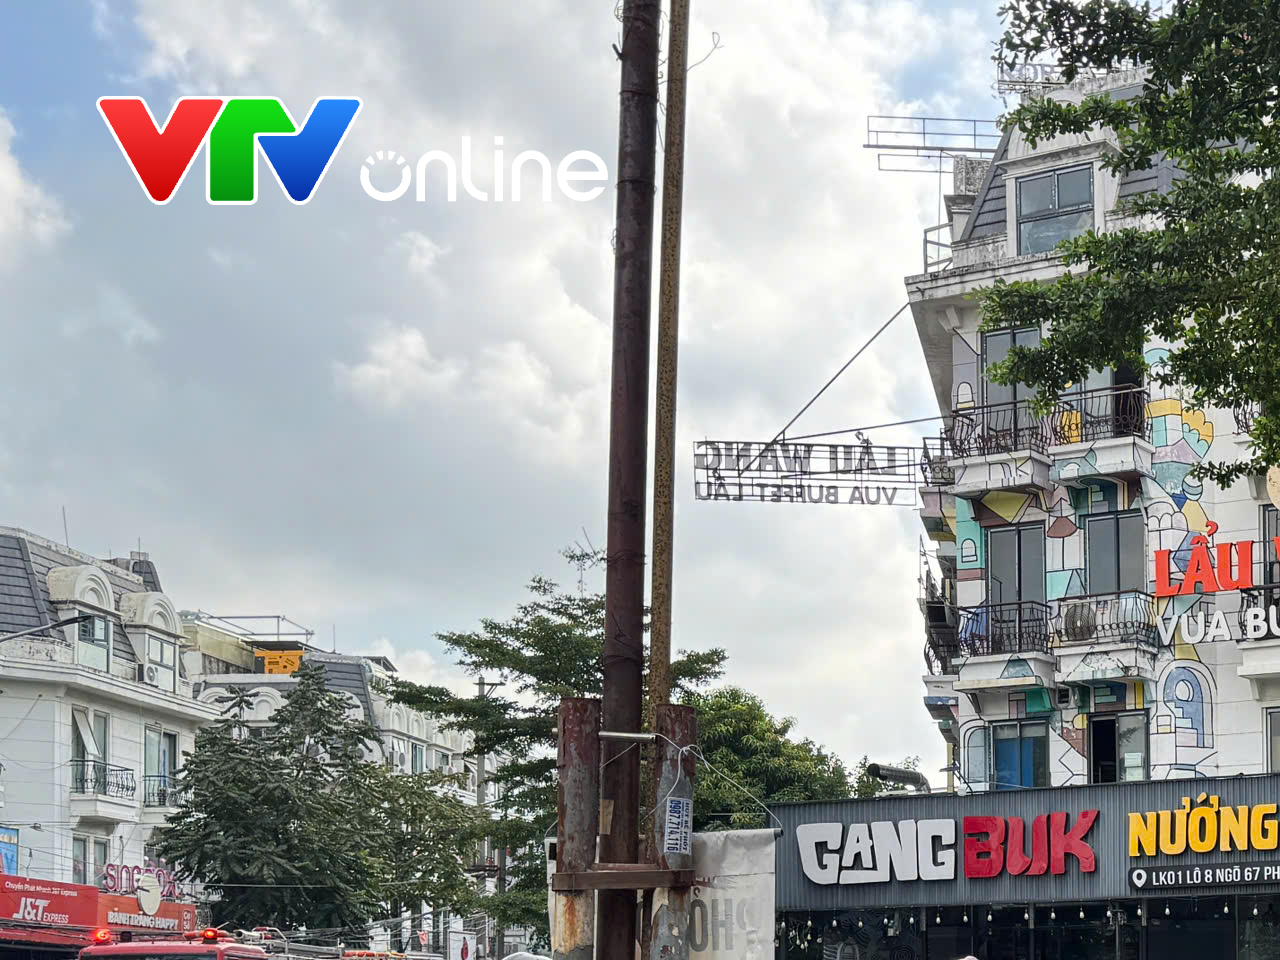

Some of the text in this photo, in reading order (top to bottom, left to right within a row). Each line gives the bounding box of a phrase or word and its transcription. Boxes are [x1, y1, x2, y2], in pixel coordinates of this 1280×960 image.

[1154, 520, 1254, 597] LẨU
[1156, 611, 1231, 646] VUA
[1128, 791, 1279, 857] NƯỚNG
[796, 809, 1099, 885] GANG BUK
[1152, 870, 1184, 886] LK01
[1187, 866, 1202, 884] LÔ
[1204, 869, 1213, 883] 8
[1216, 863, 1240, 882] NGÕ
[1244, 867, 1260, 881] 67
[12, 897, 70, 924] J&T EXPRESS
[154, 916, 178, 930] HAPPY
